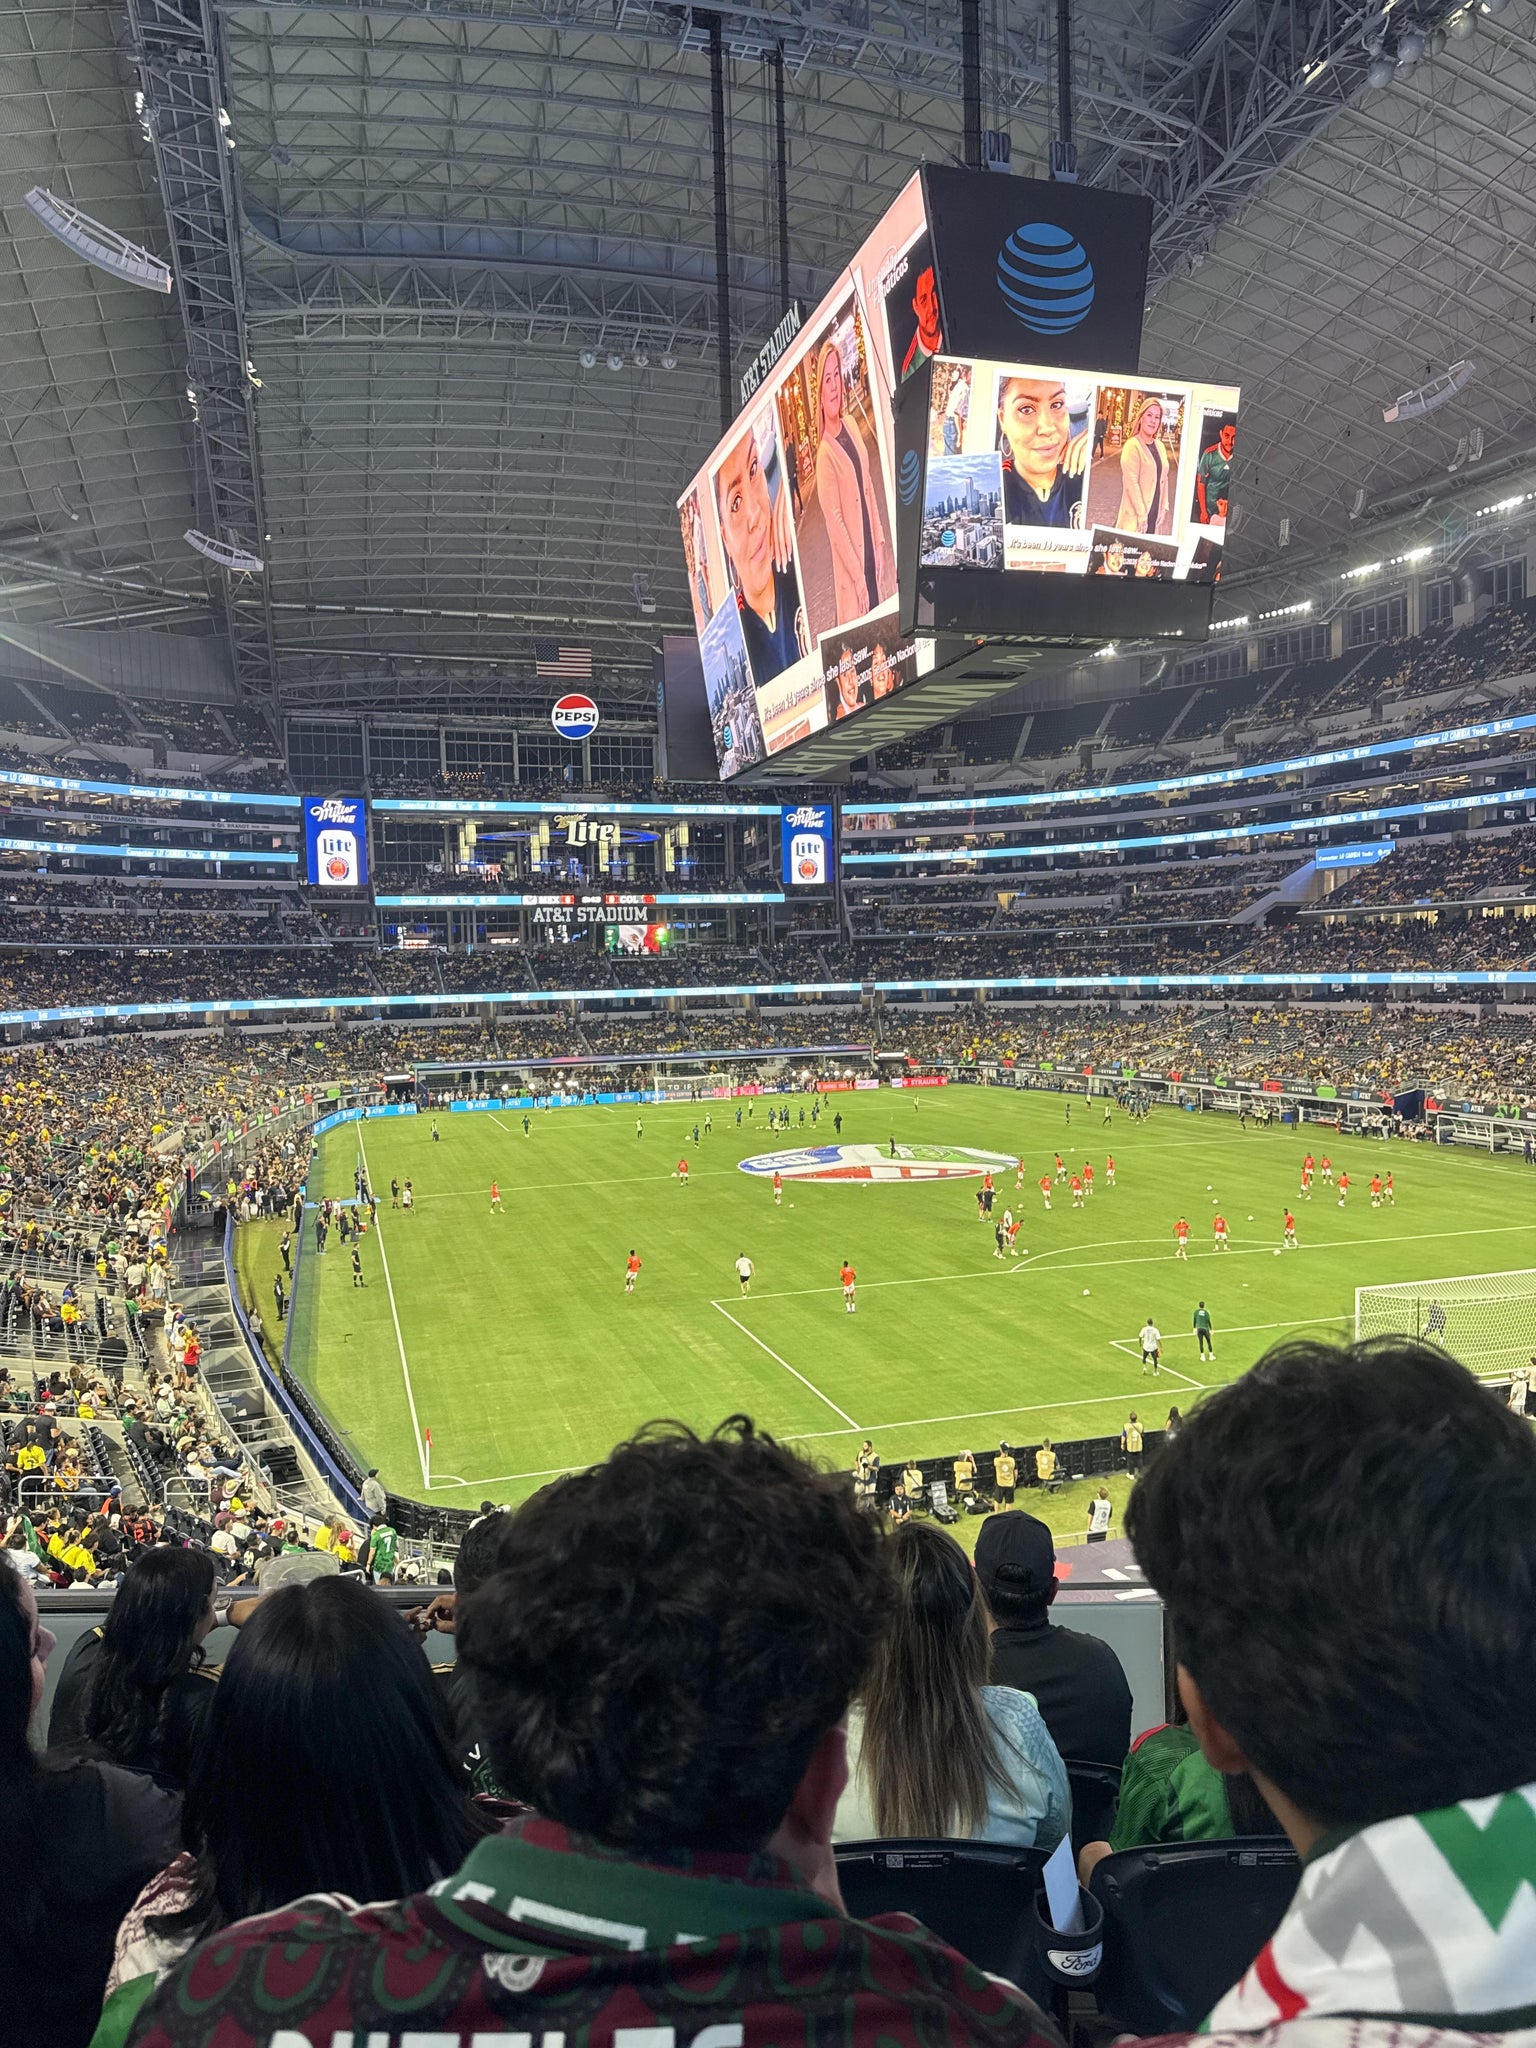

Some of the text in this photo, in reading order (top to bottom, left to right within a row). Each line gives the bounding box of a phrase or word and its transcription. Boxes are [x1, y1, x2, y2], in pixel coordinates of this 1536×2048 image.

[741, 300, 801, 405] AT&T STADIUM
[964, 634, 1155, 647] WINSTAR
[826, 665, 839, 682] she
[839, 656, 852, 673] last
[555, 711, 596, 723] PEPSI
[1472, 727, 1488, 736] Todo
[1501, 721, 1514, 730] AT&T
[110, 815, 137, 824] PEARSON
[310, 805, 357, 822] Miller
[332, 815, 356, 824] TIME
[786, 811, 826, 828] Miller
[804, 820, 824, 829] TIME
[565, 820, 615, 847] Lite
[323, 838, 352, 855] Lite
[796, 842, 820, 857] Lite
[538, 895, 560, 905] MEX
[620, 895, 639, 904] COL
[533, 906, 648, 922] AT&T STADIUM
[1470, 1105, 1485, 1113] AT&T
[383, 1535, 392, 1553] 7
[1061, 1953, 1099, 1971] Ford
